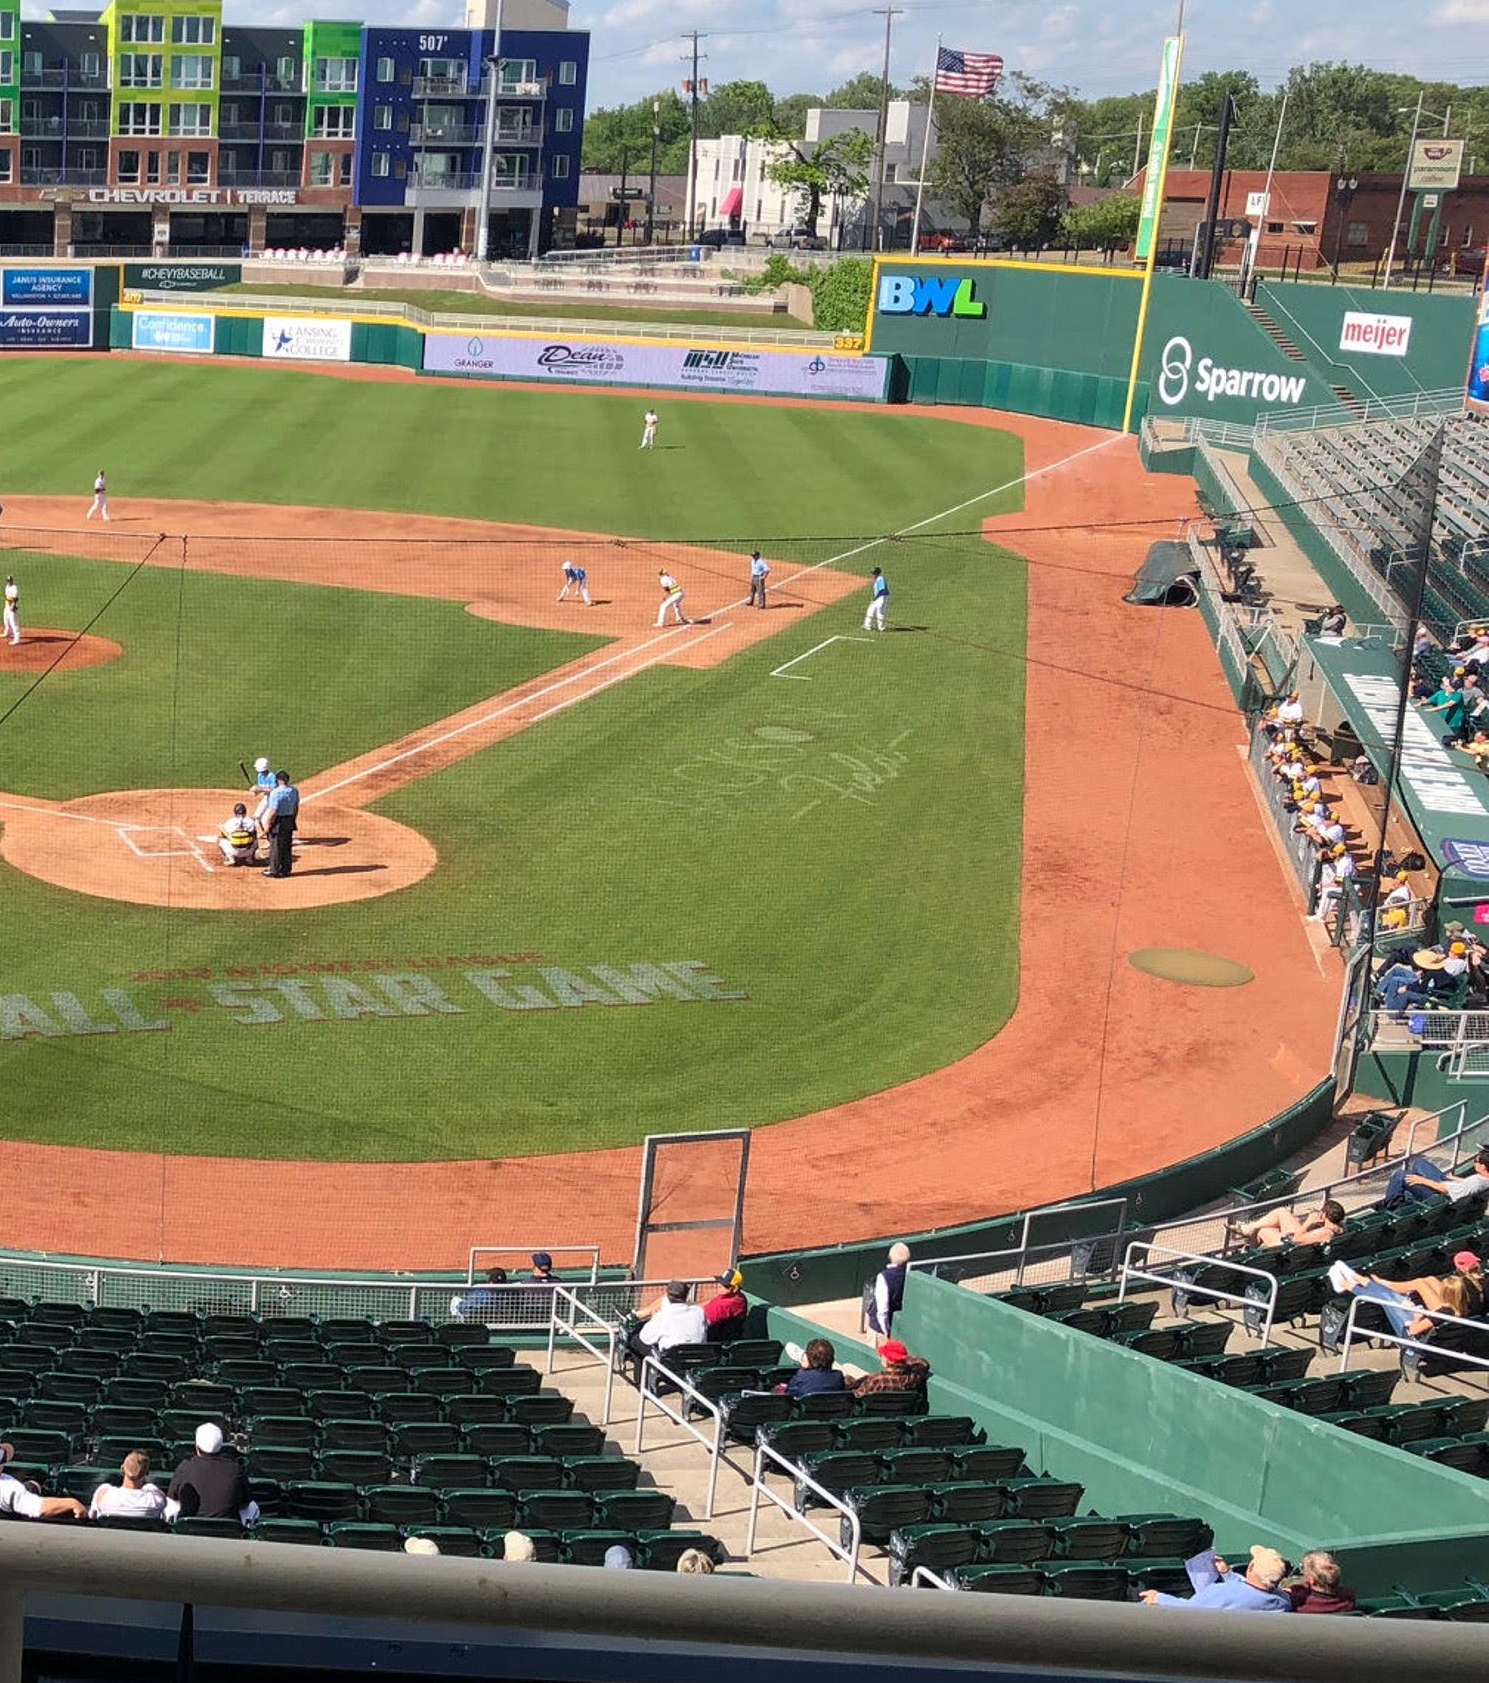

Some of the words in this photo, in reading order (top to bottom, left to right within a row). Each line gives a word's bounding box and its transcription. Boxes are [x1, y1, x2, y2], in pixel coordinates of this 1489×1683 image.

[419, 35, 448, 51] 507'
[89, 188, 221, 204] CHEVROLET
[237, 190, 296, 204] TERRACE
[31, 284, 63, 292] AGENCY
[39, 276, 82, 284] INSURANCE
[878, 276, 987, 319] BWL
[0, 315, 79, 328] Auto-Owners
[1344, 318, 1408, 350] meijer
[454, 358, 494, 369] GRANGER
[537, 345, 607, 367] Dean
[1194, 356, 1306, 404] Sparrow
[0, 988, 172, 1040] ALL
[208, 974, 468, 1024] STAR
[465, 960, 752, 1012] GAME
